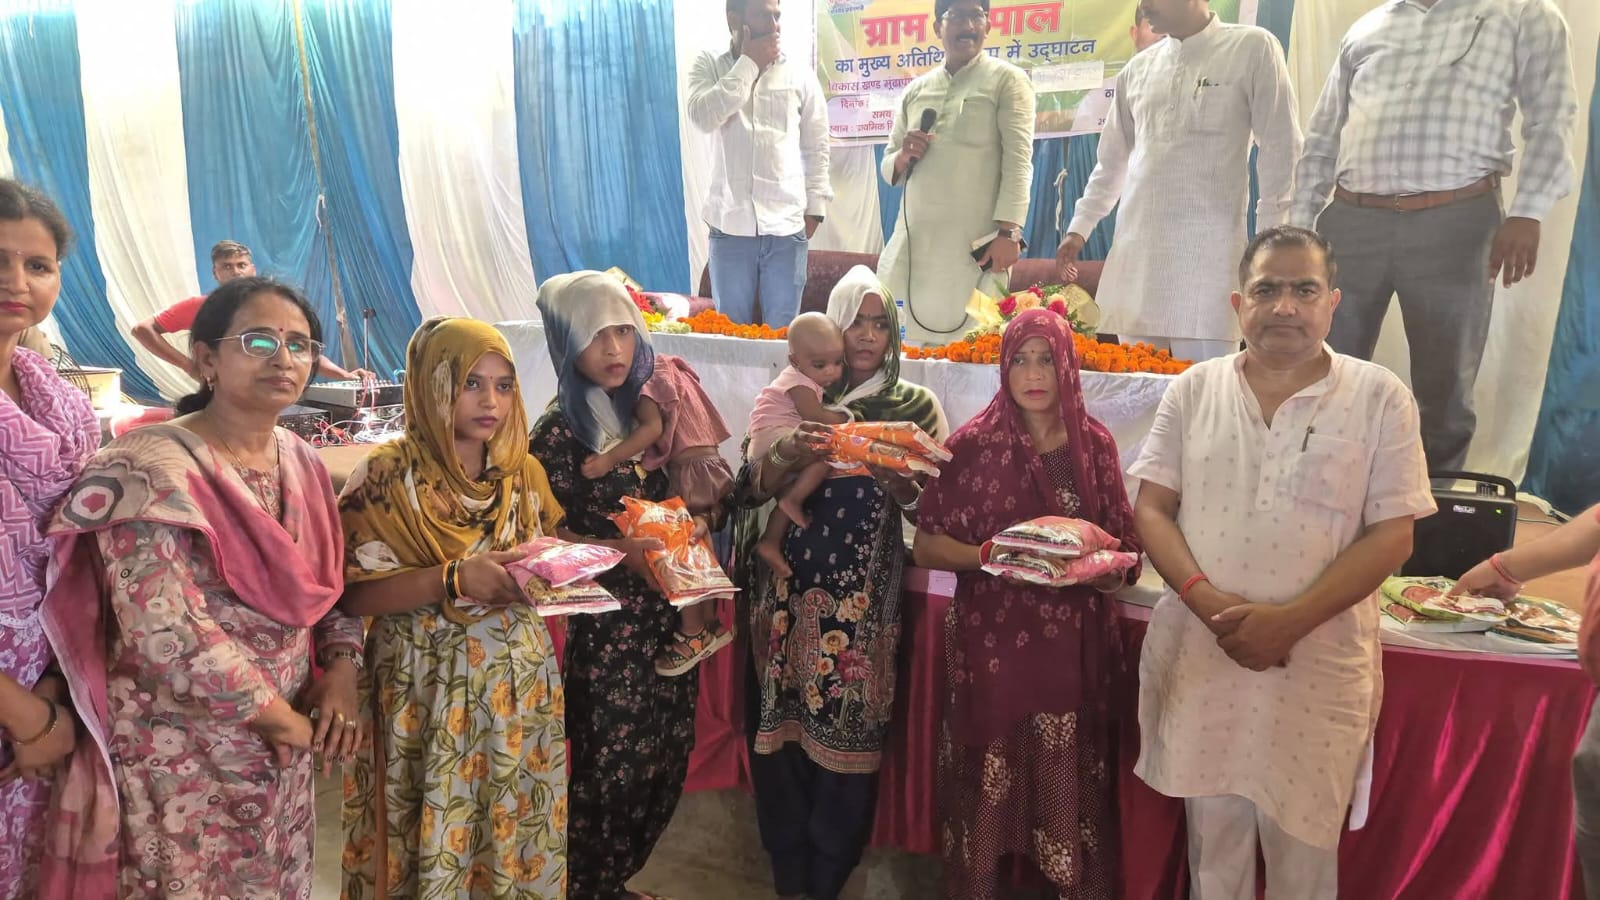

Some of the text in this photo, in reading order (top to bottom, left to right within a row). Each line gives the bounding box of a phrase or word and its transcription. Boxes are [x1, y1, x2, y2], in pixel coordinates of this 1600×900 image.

[861, 1, 1064, 47] ग्राम पाल
[835, 59, 854, 73] का
[858, 55, 891, 77] मुख्य
[1006, 39, 1022, 59] में
[862, 80, 881, 90] खण्ड
[872, 110, 893, 119] समय
